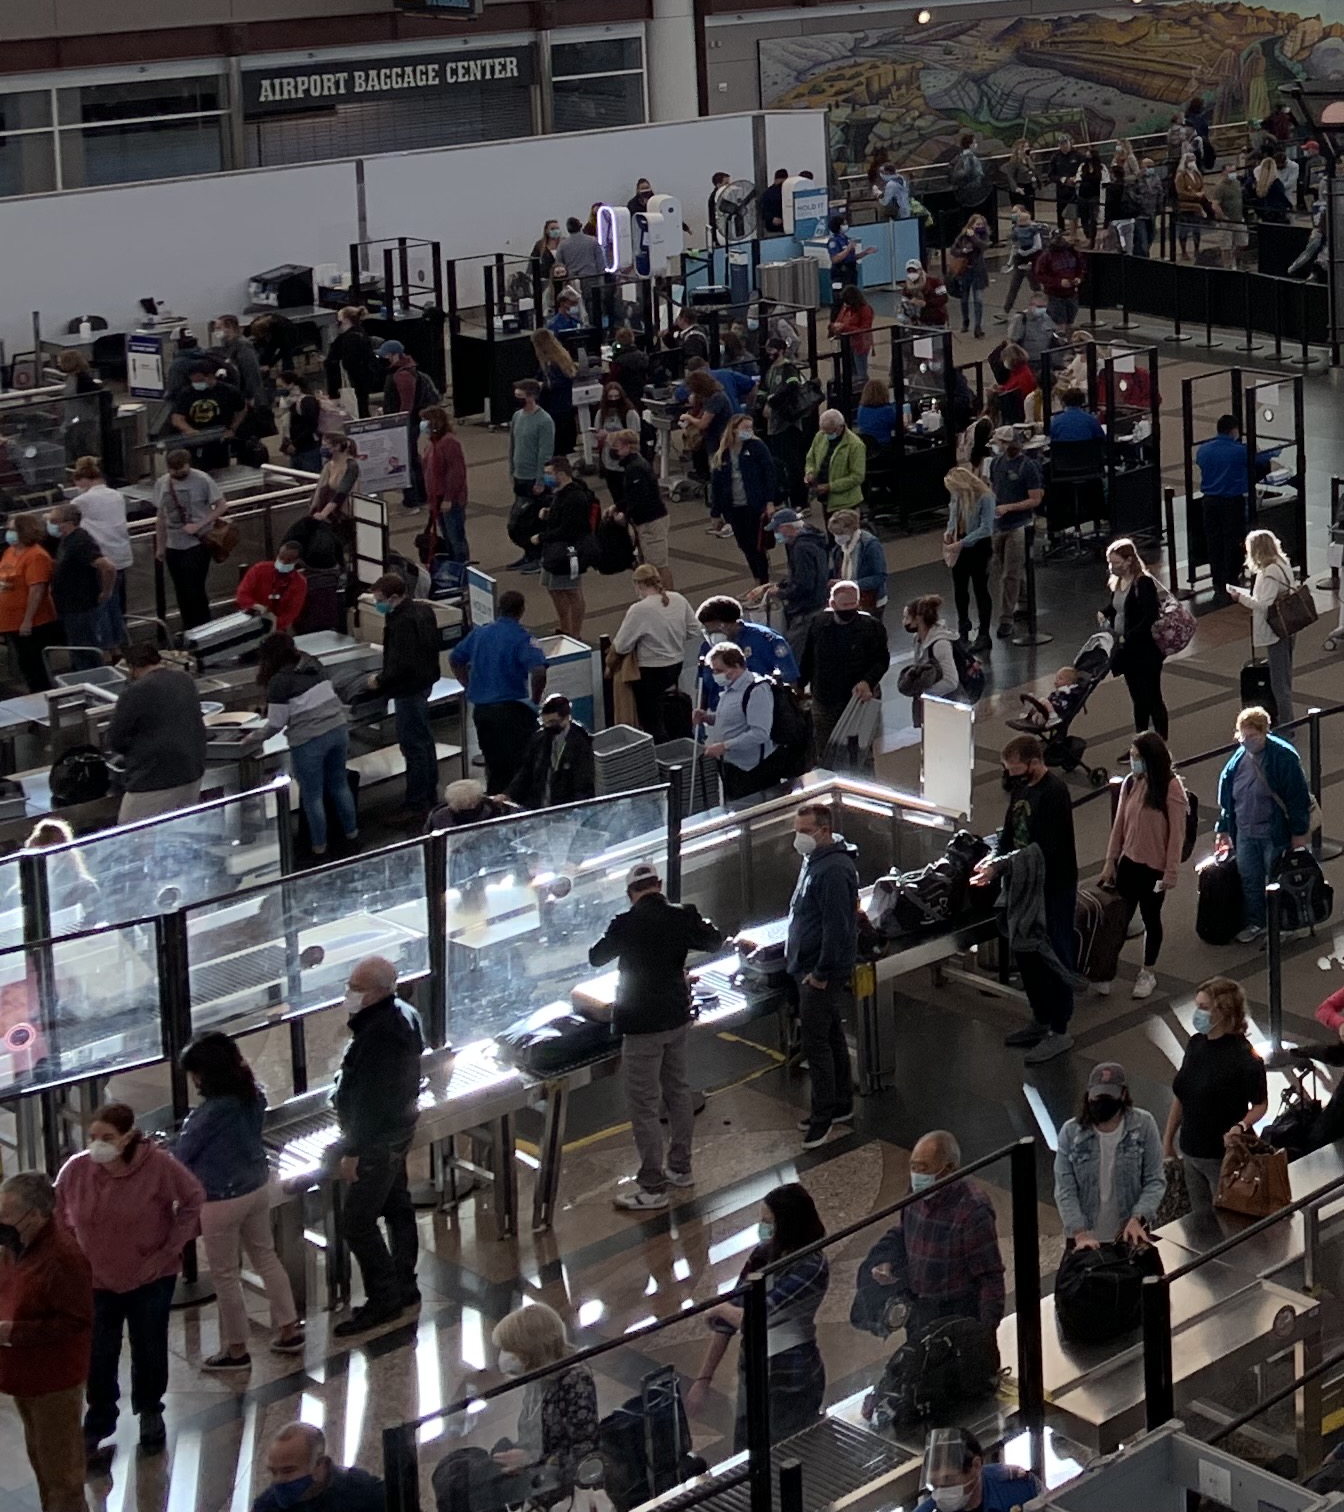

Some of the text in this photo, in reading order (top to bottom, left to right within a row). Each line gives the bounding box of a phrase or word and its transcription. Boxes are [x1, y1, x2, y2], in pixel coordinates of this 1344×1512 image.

[259, 56, 519, 102] AIRPORT BAGGAGE CENTER
